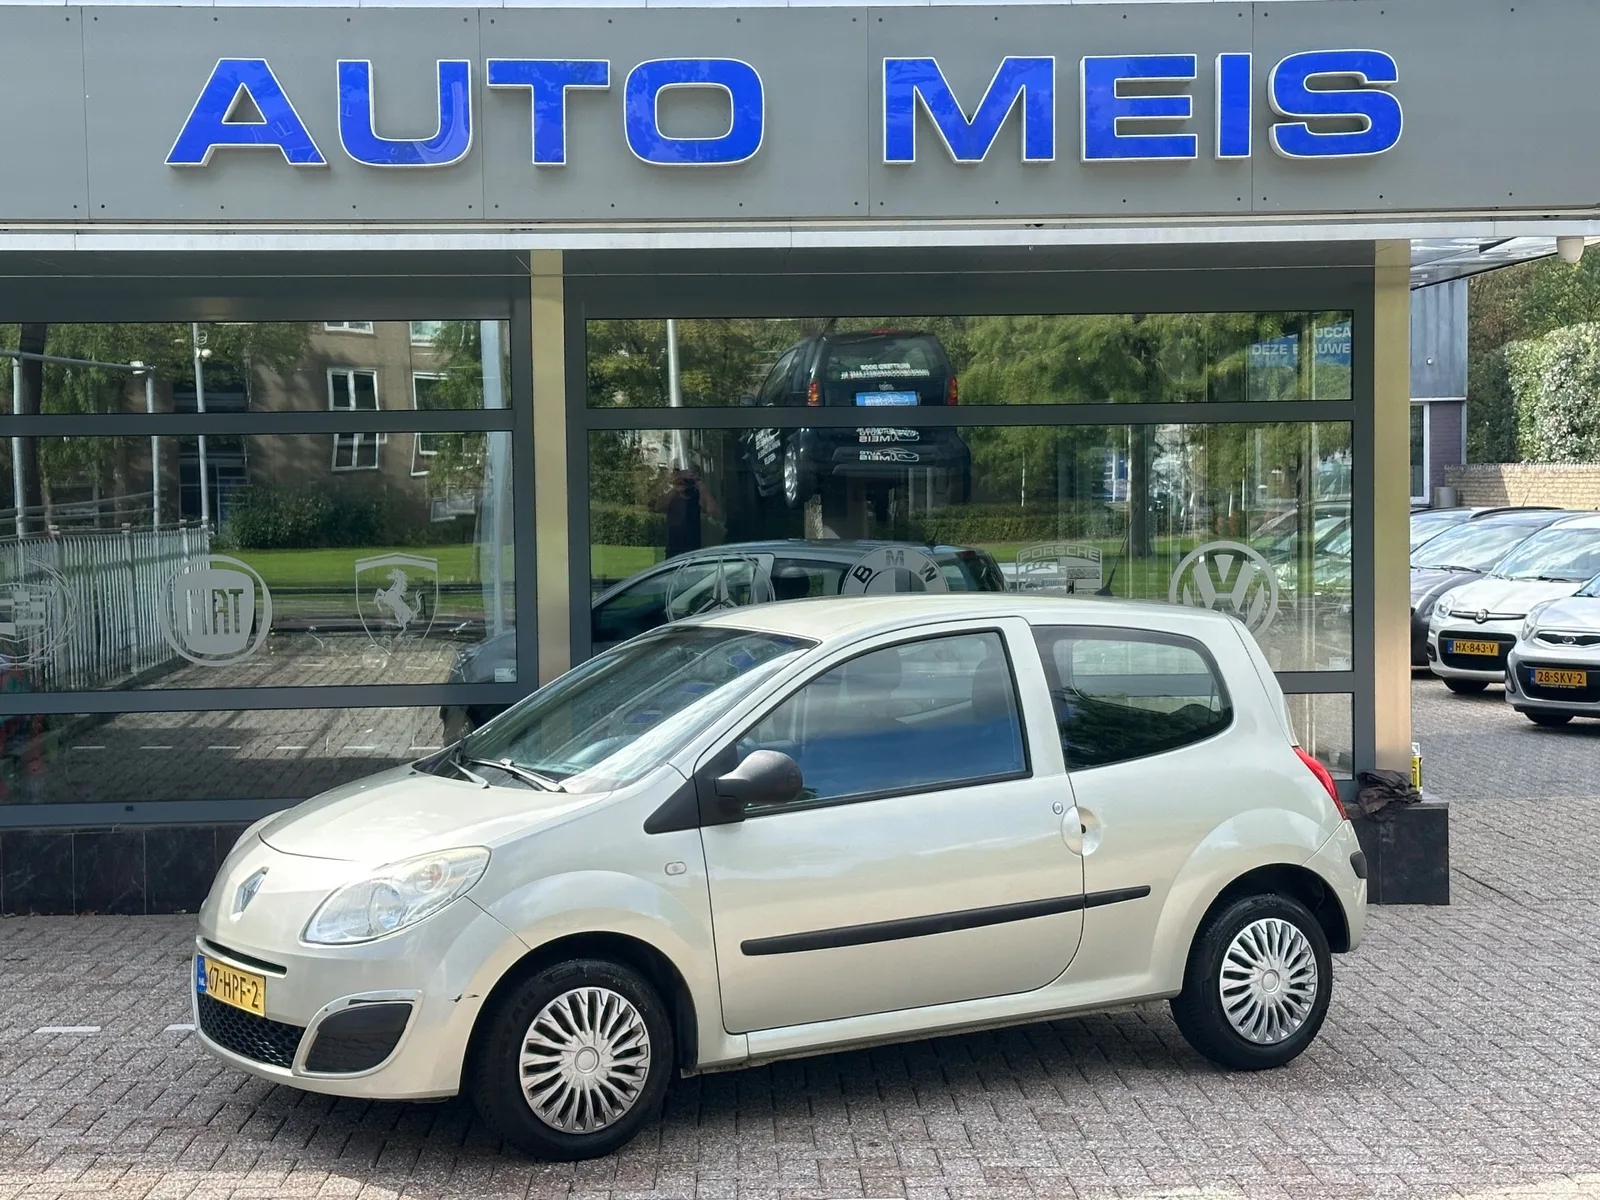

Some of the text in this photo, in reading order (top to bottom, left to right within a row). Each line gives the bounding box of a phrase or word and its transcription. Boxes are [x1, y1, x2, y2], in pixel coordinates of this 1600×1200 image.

[164, 48, 1403, 167] AUTO MEIS
[1251, 344, 1287, 355] DEZE
[1019, 545, 1101, 563] PORSCHE
[853, 550, 937, 584] BMW
[186, 588, 244, 635] FIAT
[1455, 642, 1495, 654] HX-843-V
[1538, 671, 1583, 684] 28-SKV-2
